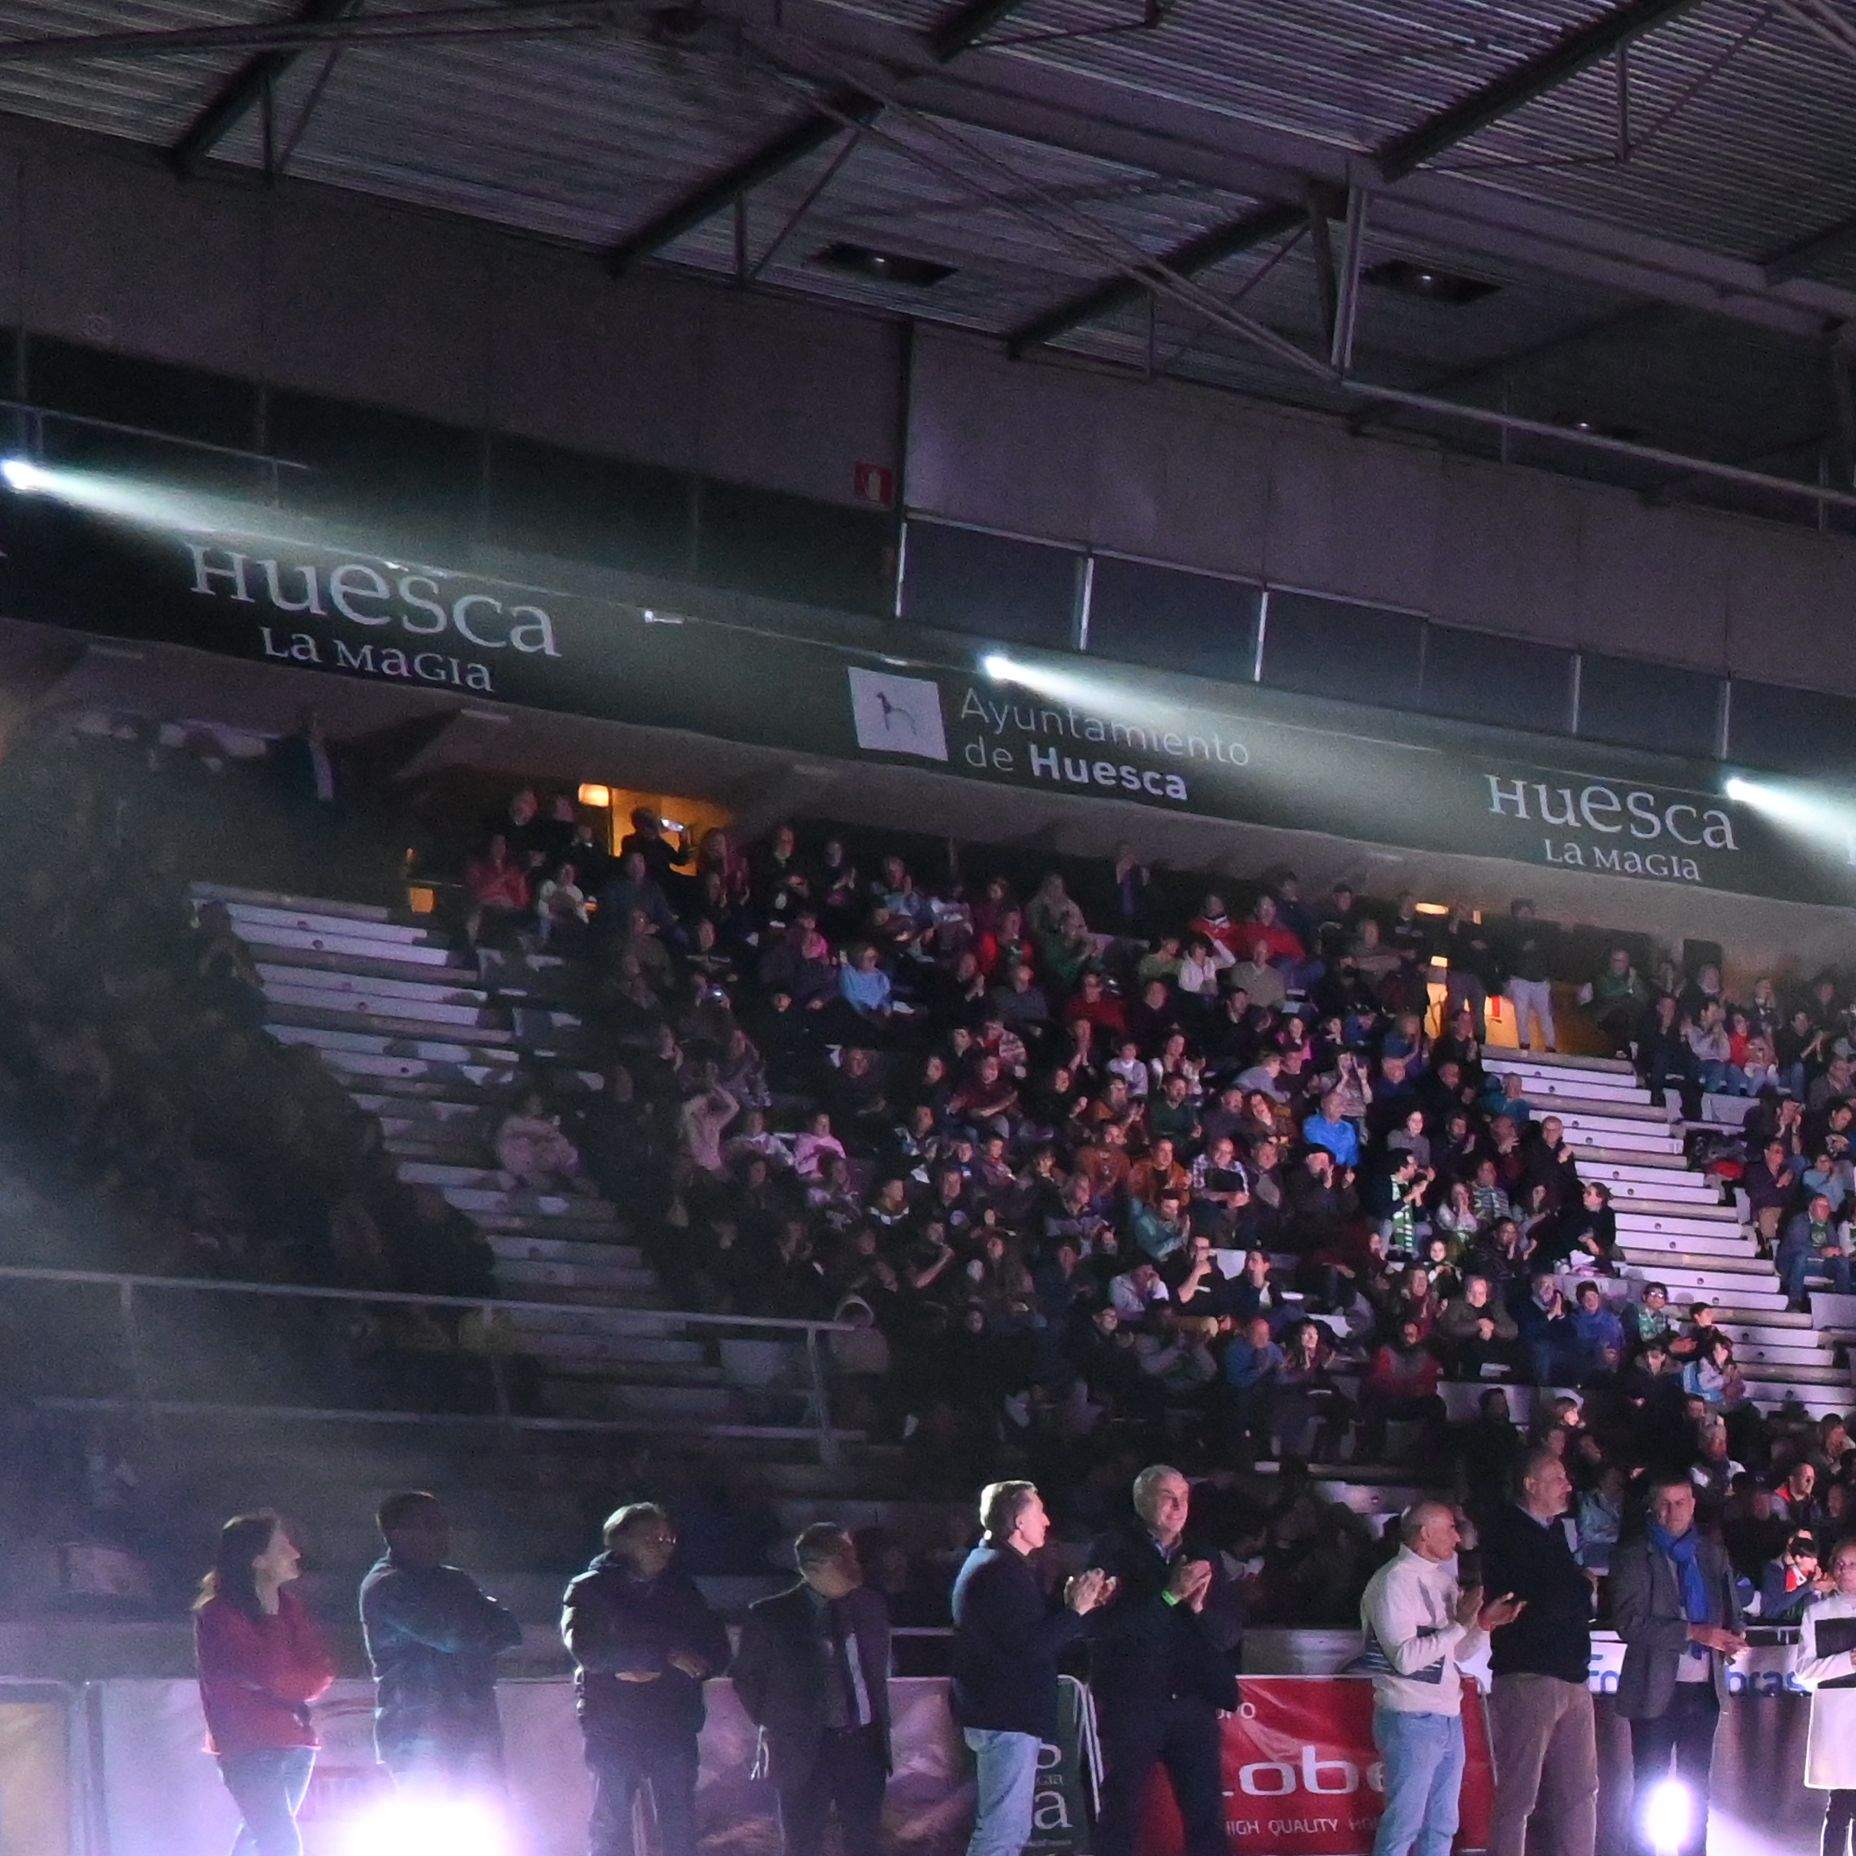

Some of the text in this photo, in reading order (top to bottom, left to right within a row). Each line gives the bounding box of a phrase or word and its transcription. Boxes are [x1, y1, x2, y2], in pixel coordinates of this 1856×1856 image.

[185, 542, 561, 658] Huesca
[258, 626, 321, 663] La
[961, 687, 1249, 766] Ayuntamiento
[965, 735, 1189, 800] de Huesca
[1484, 774, 1739, 850] Huesca
[1544, 838, 1585, 866] La
[1269, 1818, 1338, 1836] QUALITY
